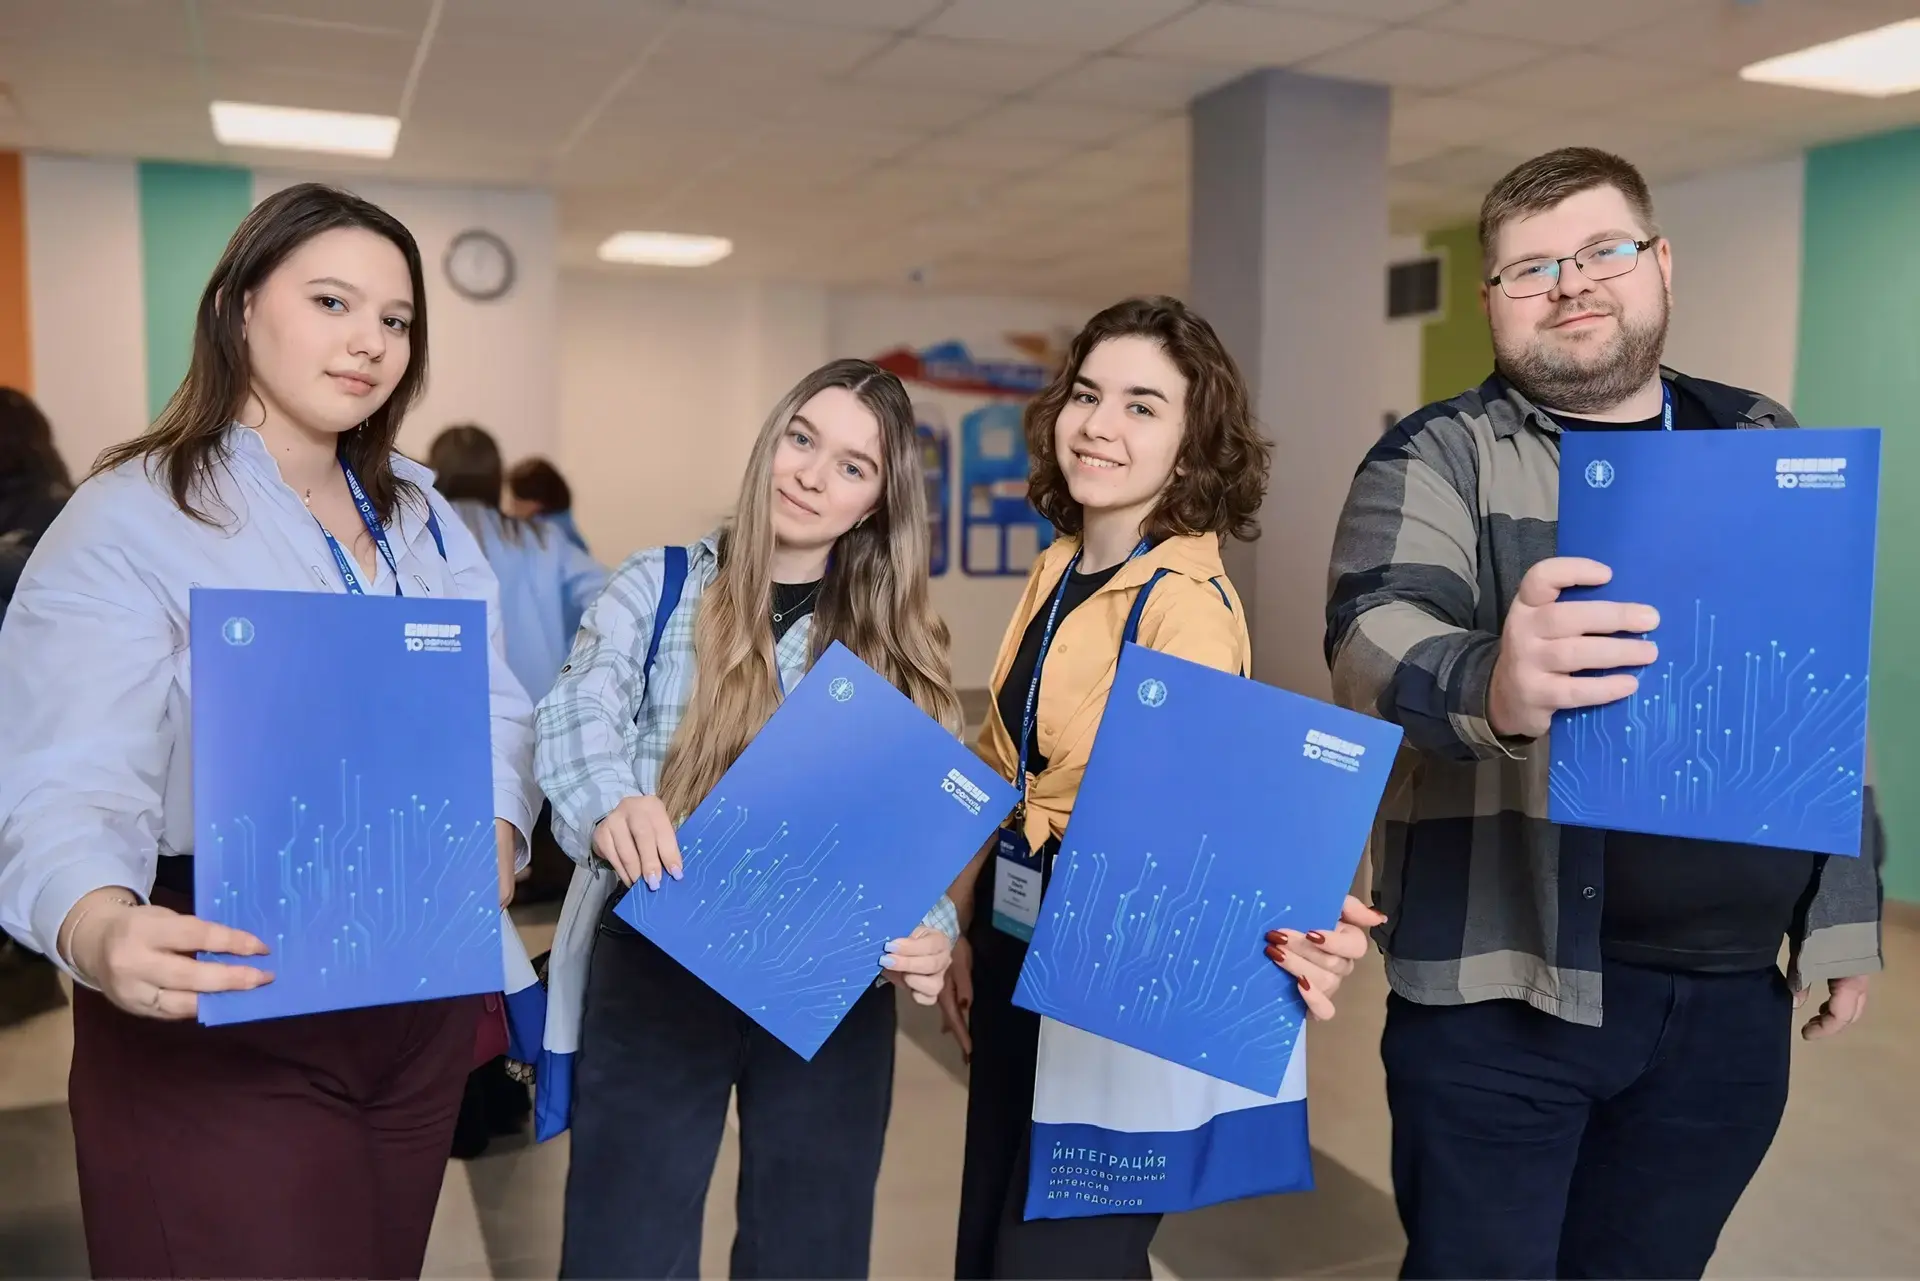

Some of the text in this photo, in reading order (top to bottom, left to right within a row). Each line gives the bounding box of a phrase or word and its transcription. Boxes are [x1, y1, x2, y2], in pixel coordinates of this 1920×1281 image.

[1775, 473, 1799, 489] 10
[359, 501, 371, 513] 10
[404, 637, 424, 652] 10
[1303, 743, 1322, 760] 10
[940, 778, 956, 793] 10
[1052, 1141, 1167, 1170] ИНТЕГРАЦИЯ
[1050, 1165, 1166, 1183] образовательный
[1049, 1178, 1110, 1192] интенсив
[1047, 1190, 1143, 1207] для педагогов
